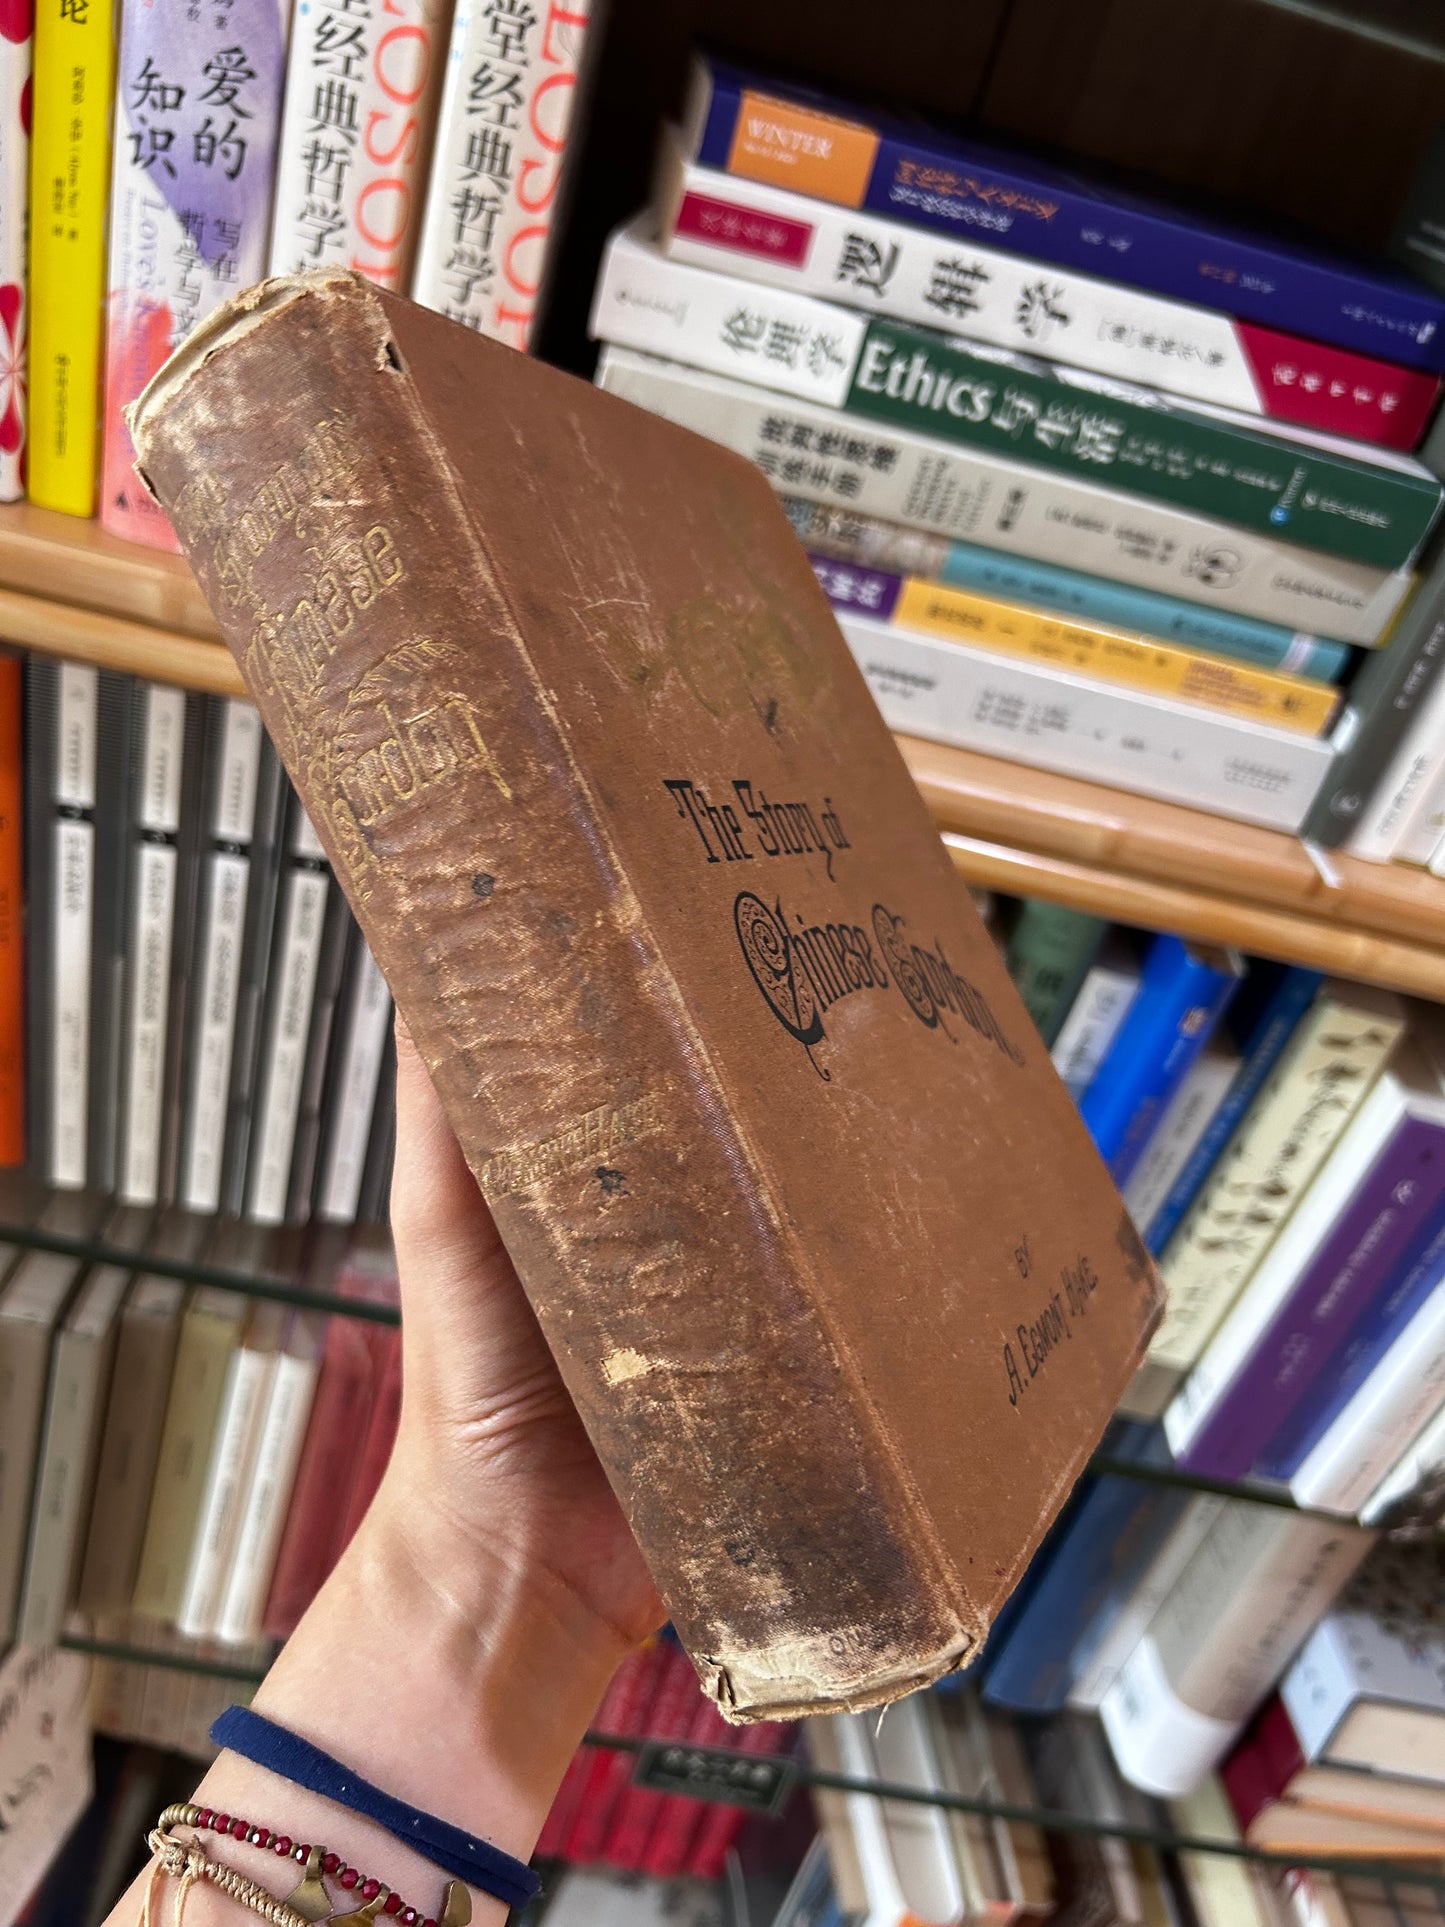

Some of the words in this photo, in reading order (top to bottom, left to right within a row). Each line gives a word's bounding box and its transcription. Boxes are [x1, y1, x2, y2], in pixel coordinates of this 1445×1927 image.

[127, 57, 186, 180] 知识
[197, 46, 257, 181] 爱的
[296, 0, 371, 275] 经典哲学
[350, 0, 432, 290] OSO
[836, 231, 1071, 342] 逻辑学
[719, 307, 848, 379] 伦理学
[854, 336, 995, 424] Ethics
[663, 778, 754, 864] The
[731, 778, 836, 884] Story
[820, 796, 853, 850] of
[733, 890, 890, 1082] Chinese
[871, 902, 1026, 1068] Gordon
[1015, 1290, 1073, 1379] EGMONT
[1060, 1252, 1099, 1318] HAKE
[1003, 1341, 1030, 1407] A.
